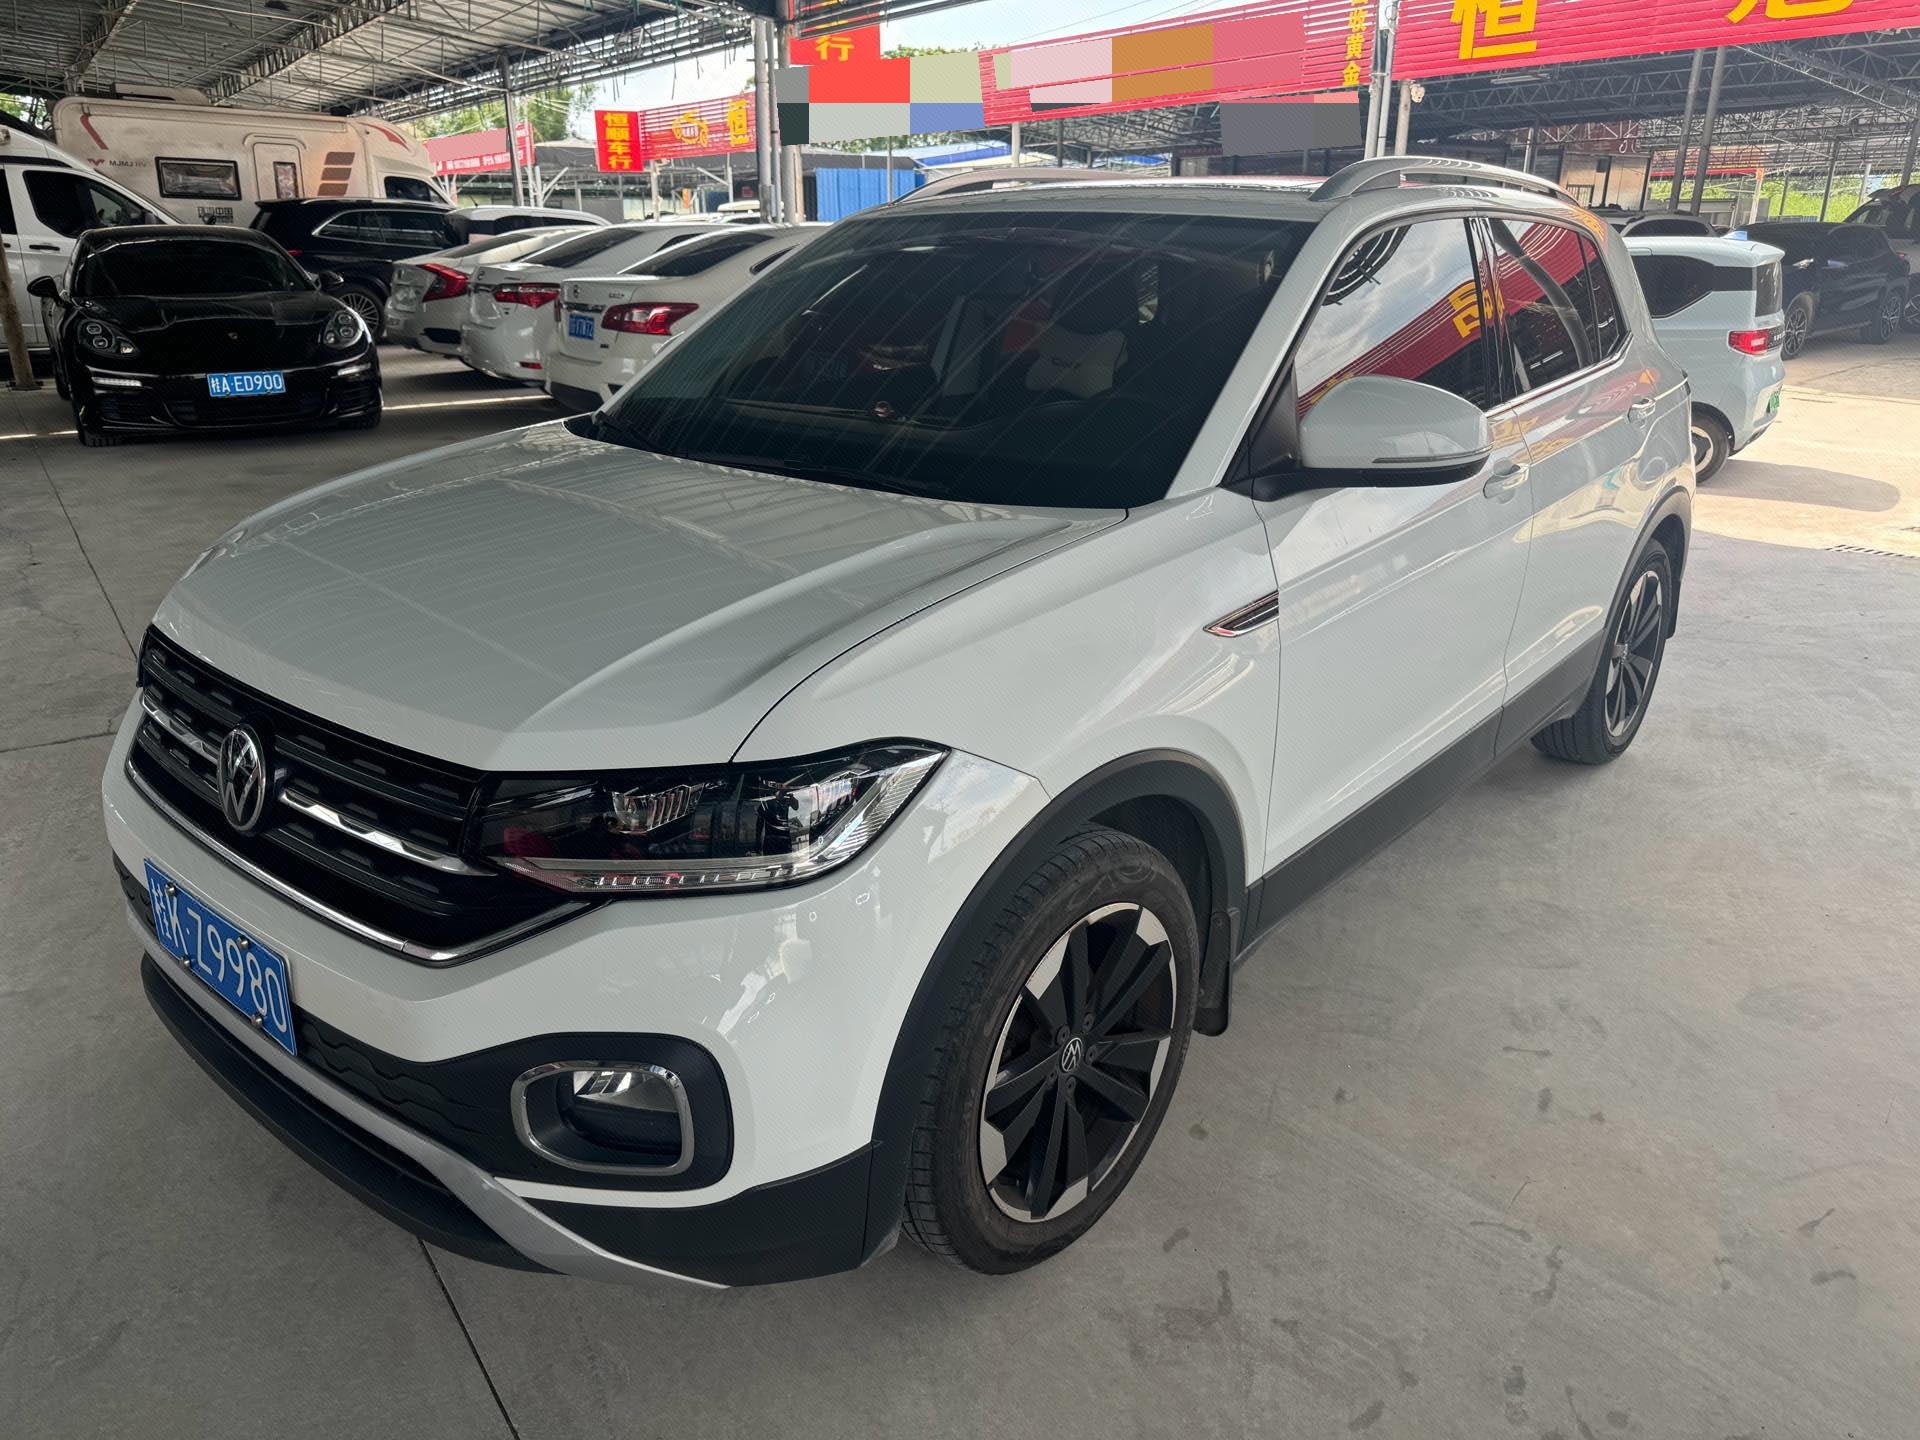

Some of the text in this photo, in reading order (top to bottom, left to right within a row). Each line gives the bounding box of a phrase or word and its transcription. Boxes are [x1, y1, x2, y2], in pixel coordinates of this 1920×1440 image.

[1342, 0, 1369, 87] 收黄金
[603, 112, 633, 170] 恒顺车行
